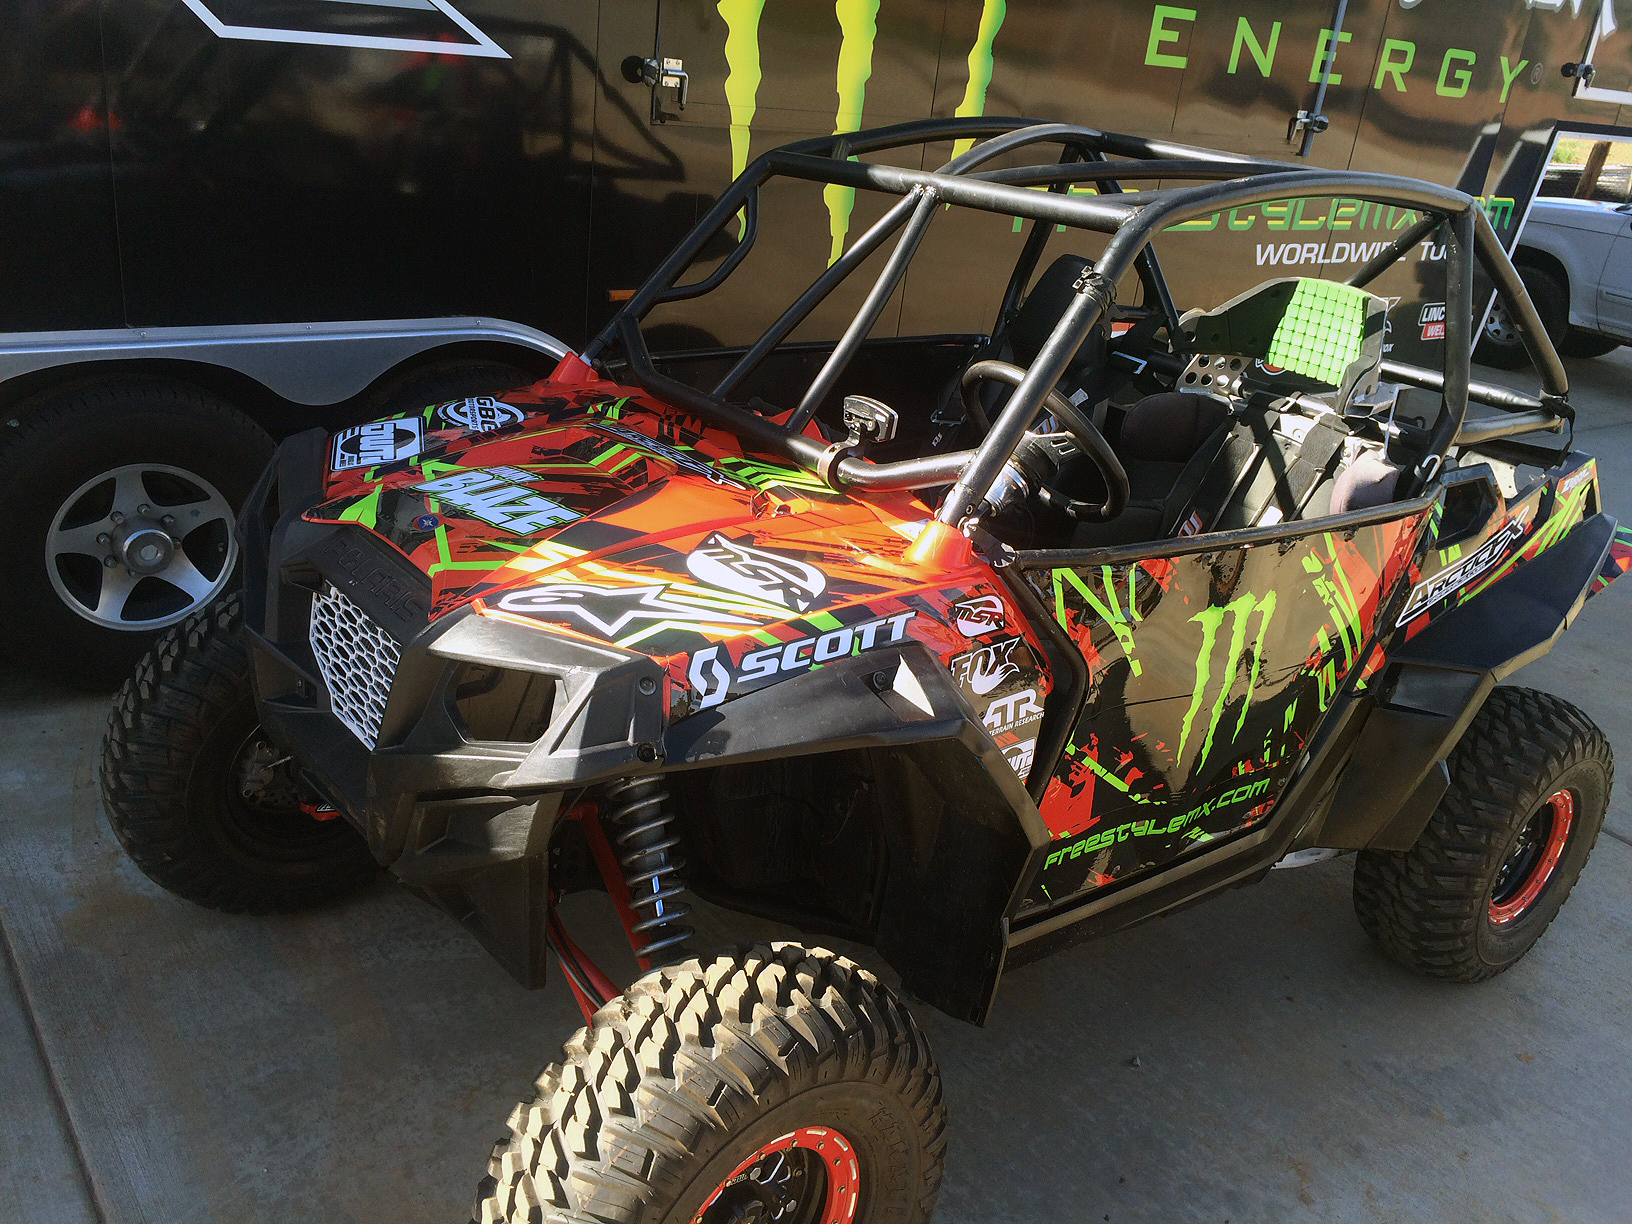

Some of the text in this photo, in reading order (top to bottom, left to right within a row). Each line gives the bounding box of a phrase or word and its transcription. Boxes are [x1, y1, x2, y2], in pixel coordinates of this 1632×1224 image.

[1144, 4, 1529, 104] ENERGY
[411, 470, 587, 536] BLAZE
[737, 611, 917, 683] SCOTT
[951, 637, 1020, 694] FOX
